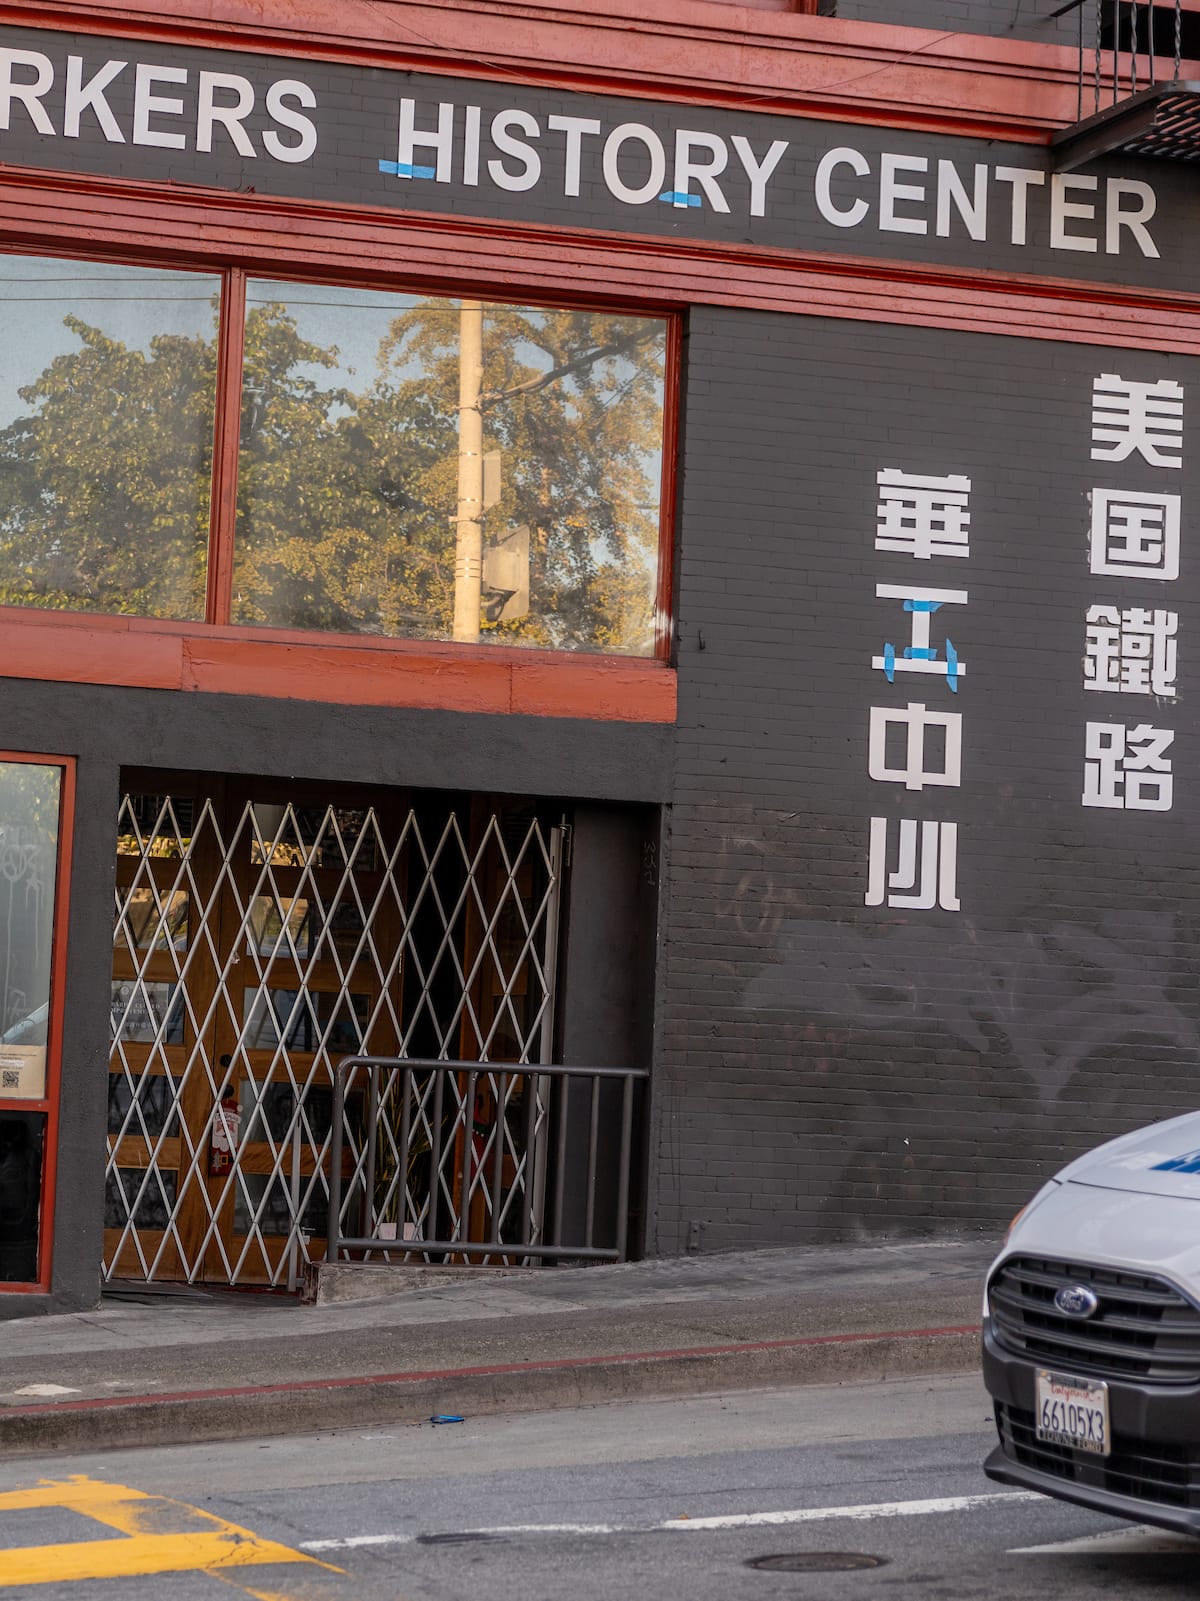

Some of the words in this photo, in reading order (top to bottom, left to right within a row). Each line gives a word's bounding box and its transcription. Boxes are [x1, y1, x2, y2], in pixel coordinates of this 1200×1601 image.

[397, 98, 789, 217] HISTORY
[814, 147, 1161, 258] CENTER
[865, 468, 971, 912] 華工中心
[1042, 1398, 1104, 1442] 66105X3
